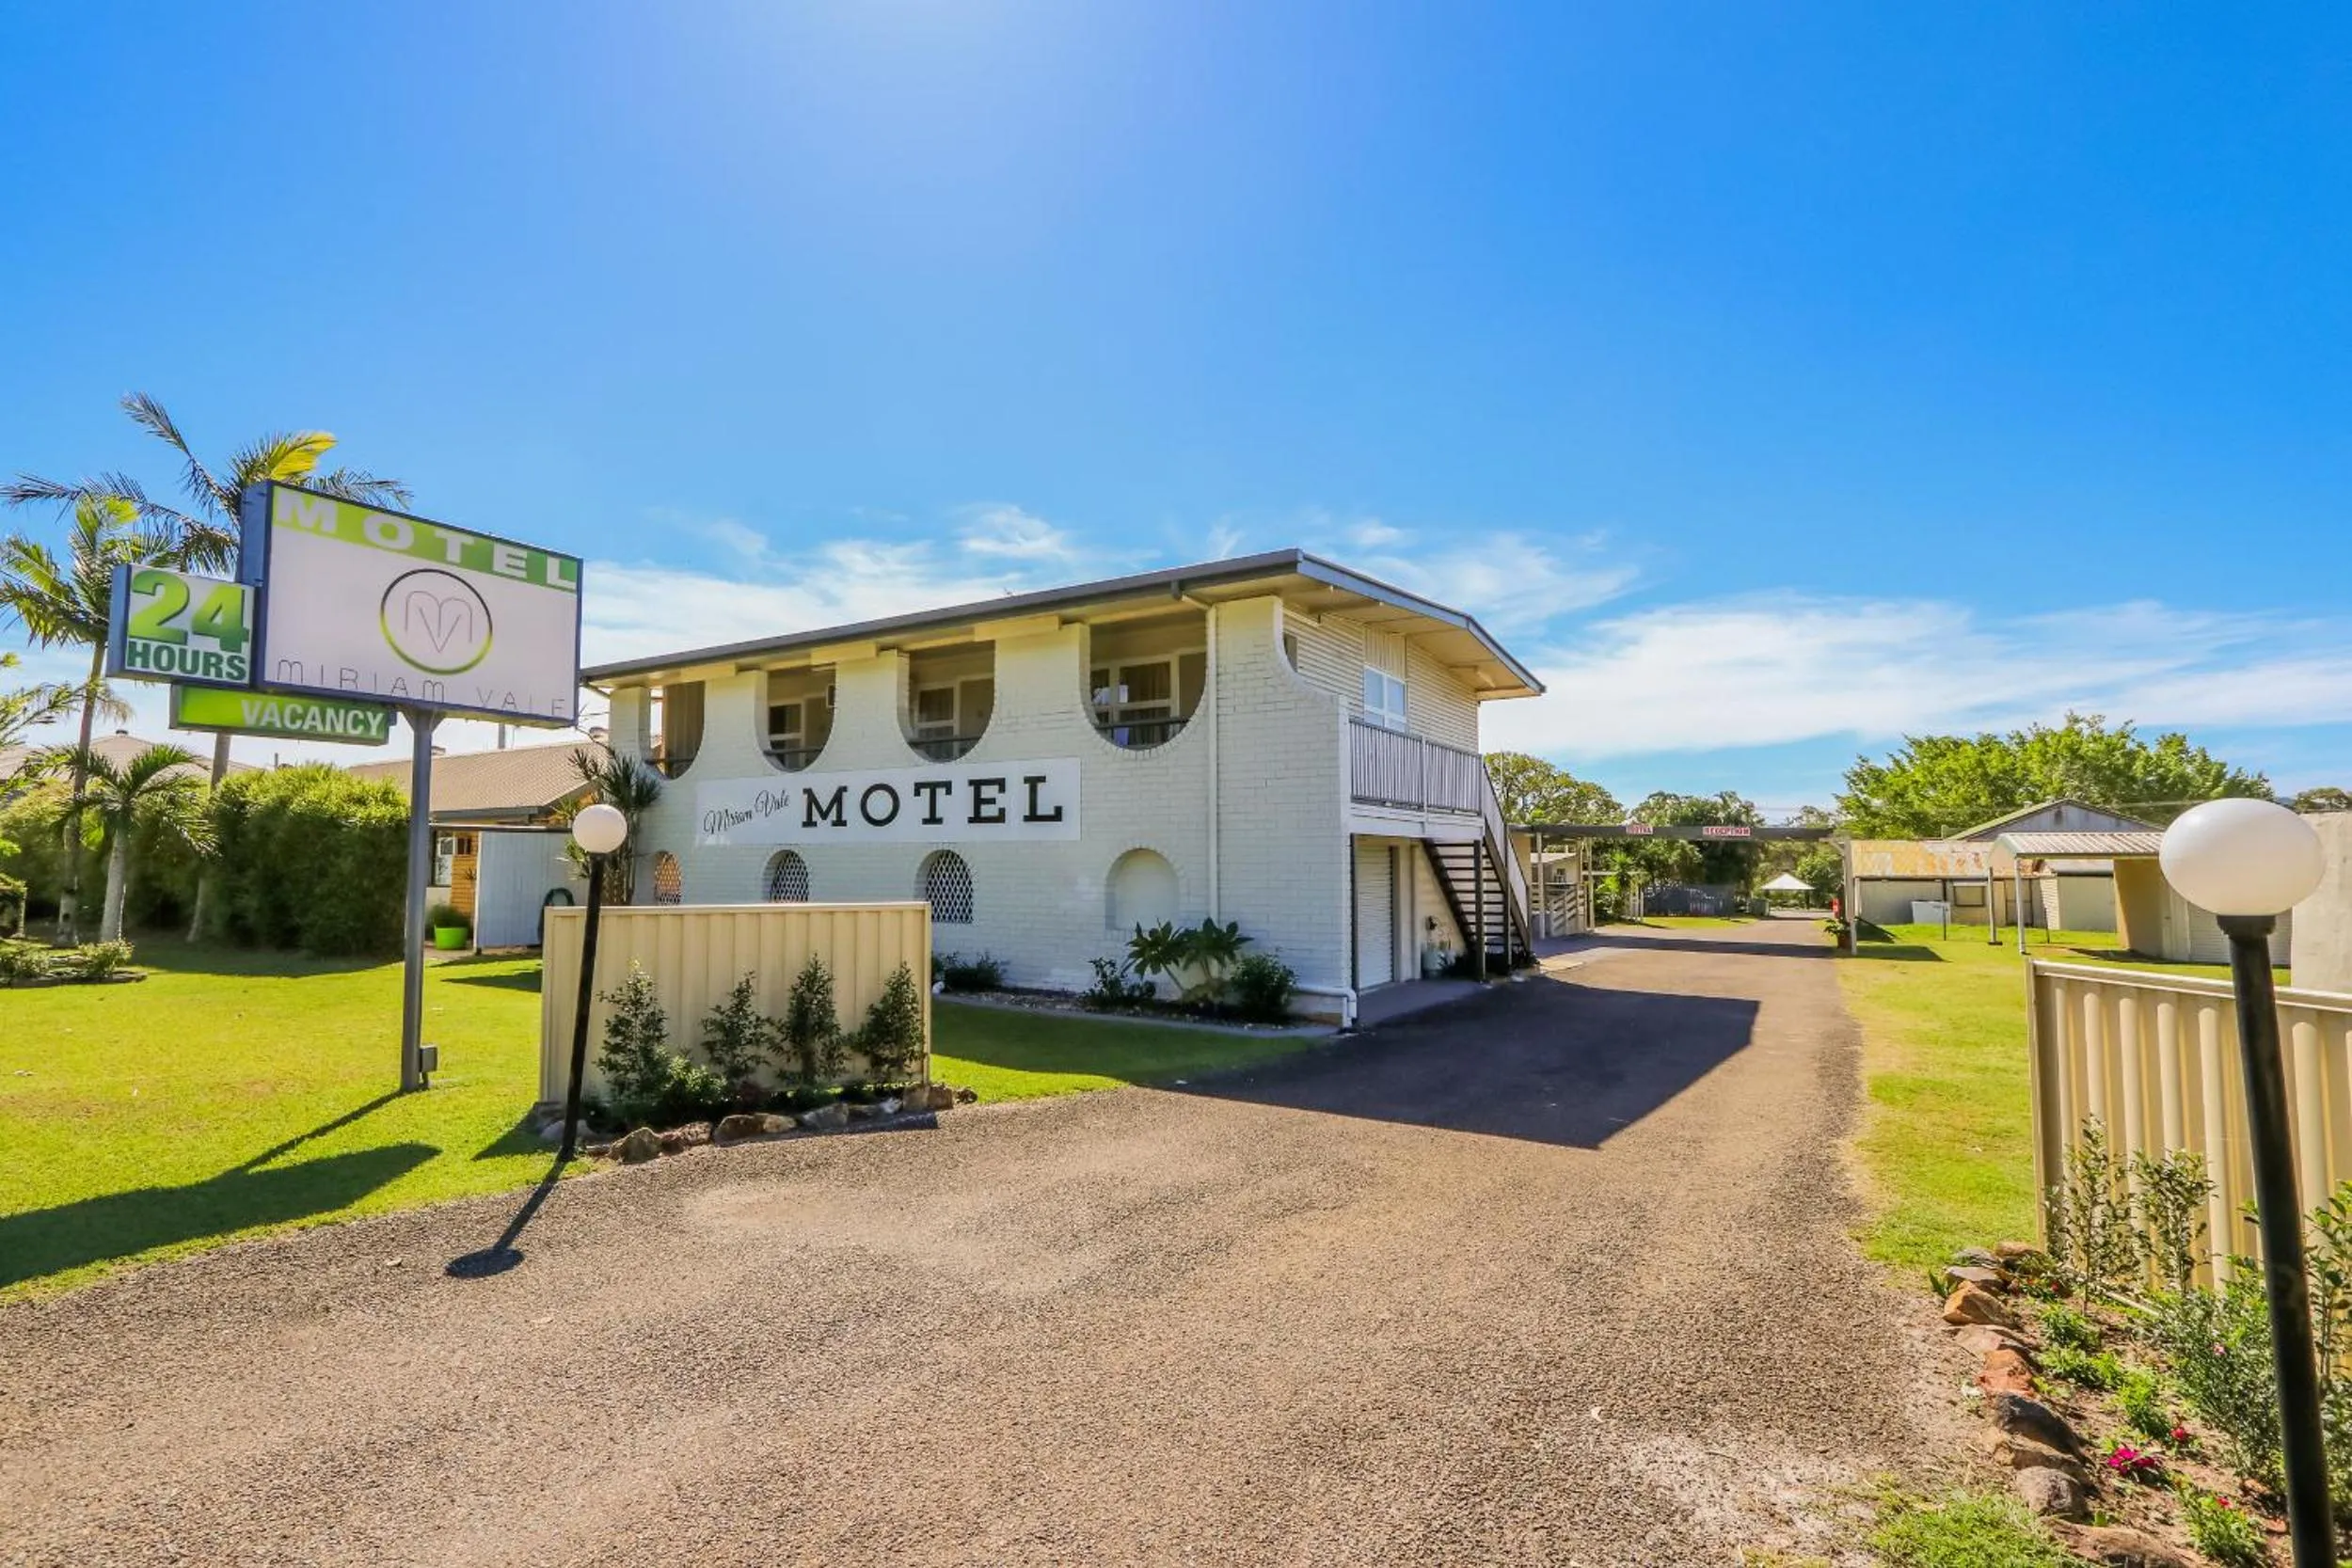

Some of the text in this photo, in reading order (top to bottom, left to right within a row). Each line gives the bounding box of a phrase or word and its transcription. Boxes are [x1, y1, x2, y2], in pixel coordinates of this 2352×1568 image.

[275, 486, 577, 590] MOTEL
[130, 570, 249, 653] 24
[126, 641, 246, 682] HOURS
[277, 659, 445, 703] MIRIAM
[242, 699, 385, 736] VACANCY
[802, 775, 1063, 828] MOTEL
